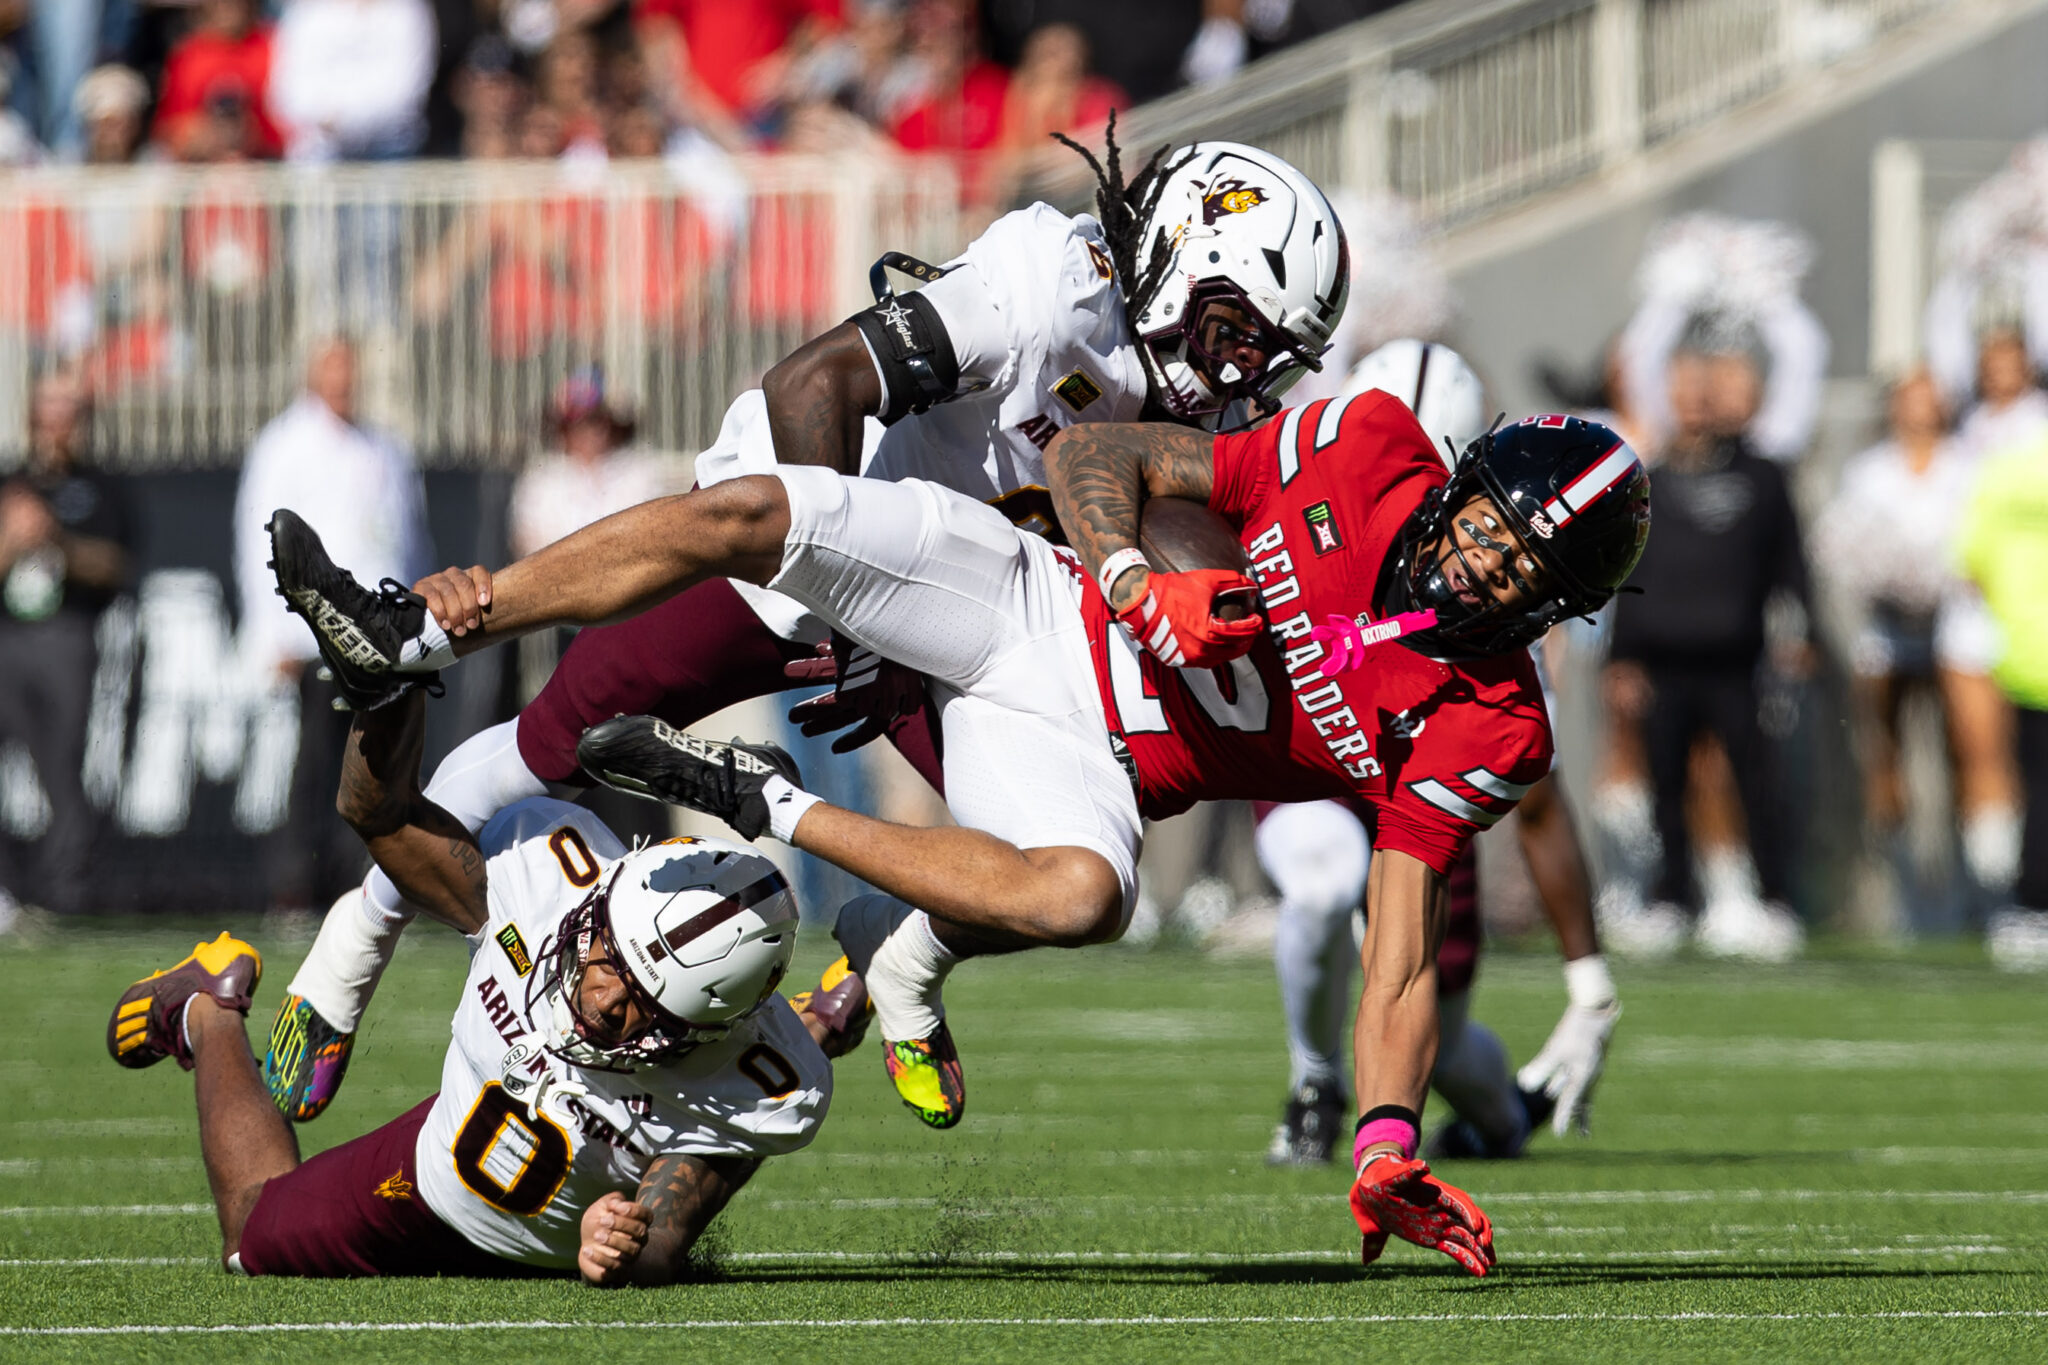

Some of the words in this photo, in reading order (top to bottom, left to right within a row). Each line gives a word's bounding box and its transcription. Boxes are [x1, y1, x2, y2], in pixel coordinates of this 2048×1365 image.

[889, 311, 914, 348] Douglas
[1529, 510, 1555, 539] Tech
[1249, 521, 1301, 611] RED
[1360, 620, 1402, 647] NXTRND
[1269, 608, 1383, 781] RAIDERS
[548, 825, 601, 888] 0
[629, 938, 648, 966] ARIZONA
[645, 963, 661, 983] STATE
[477, 974, 557, 1087] ARIZN
[737, 1043, 801, 1100] 0
[452, 1080, 573, 1217] 0
